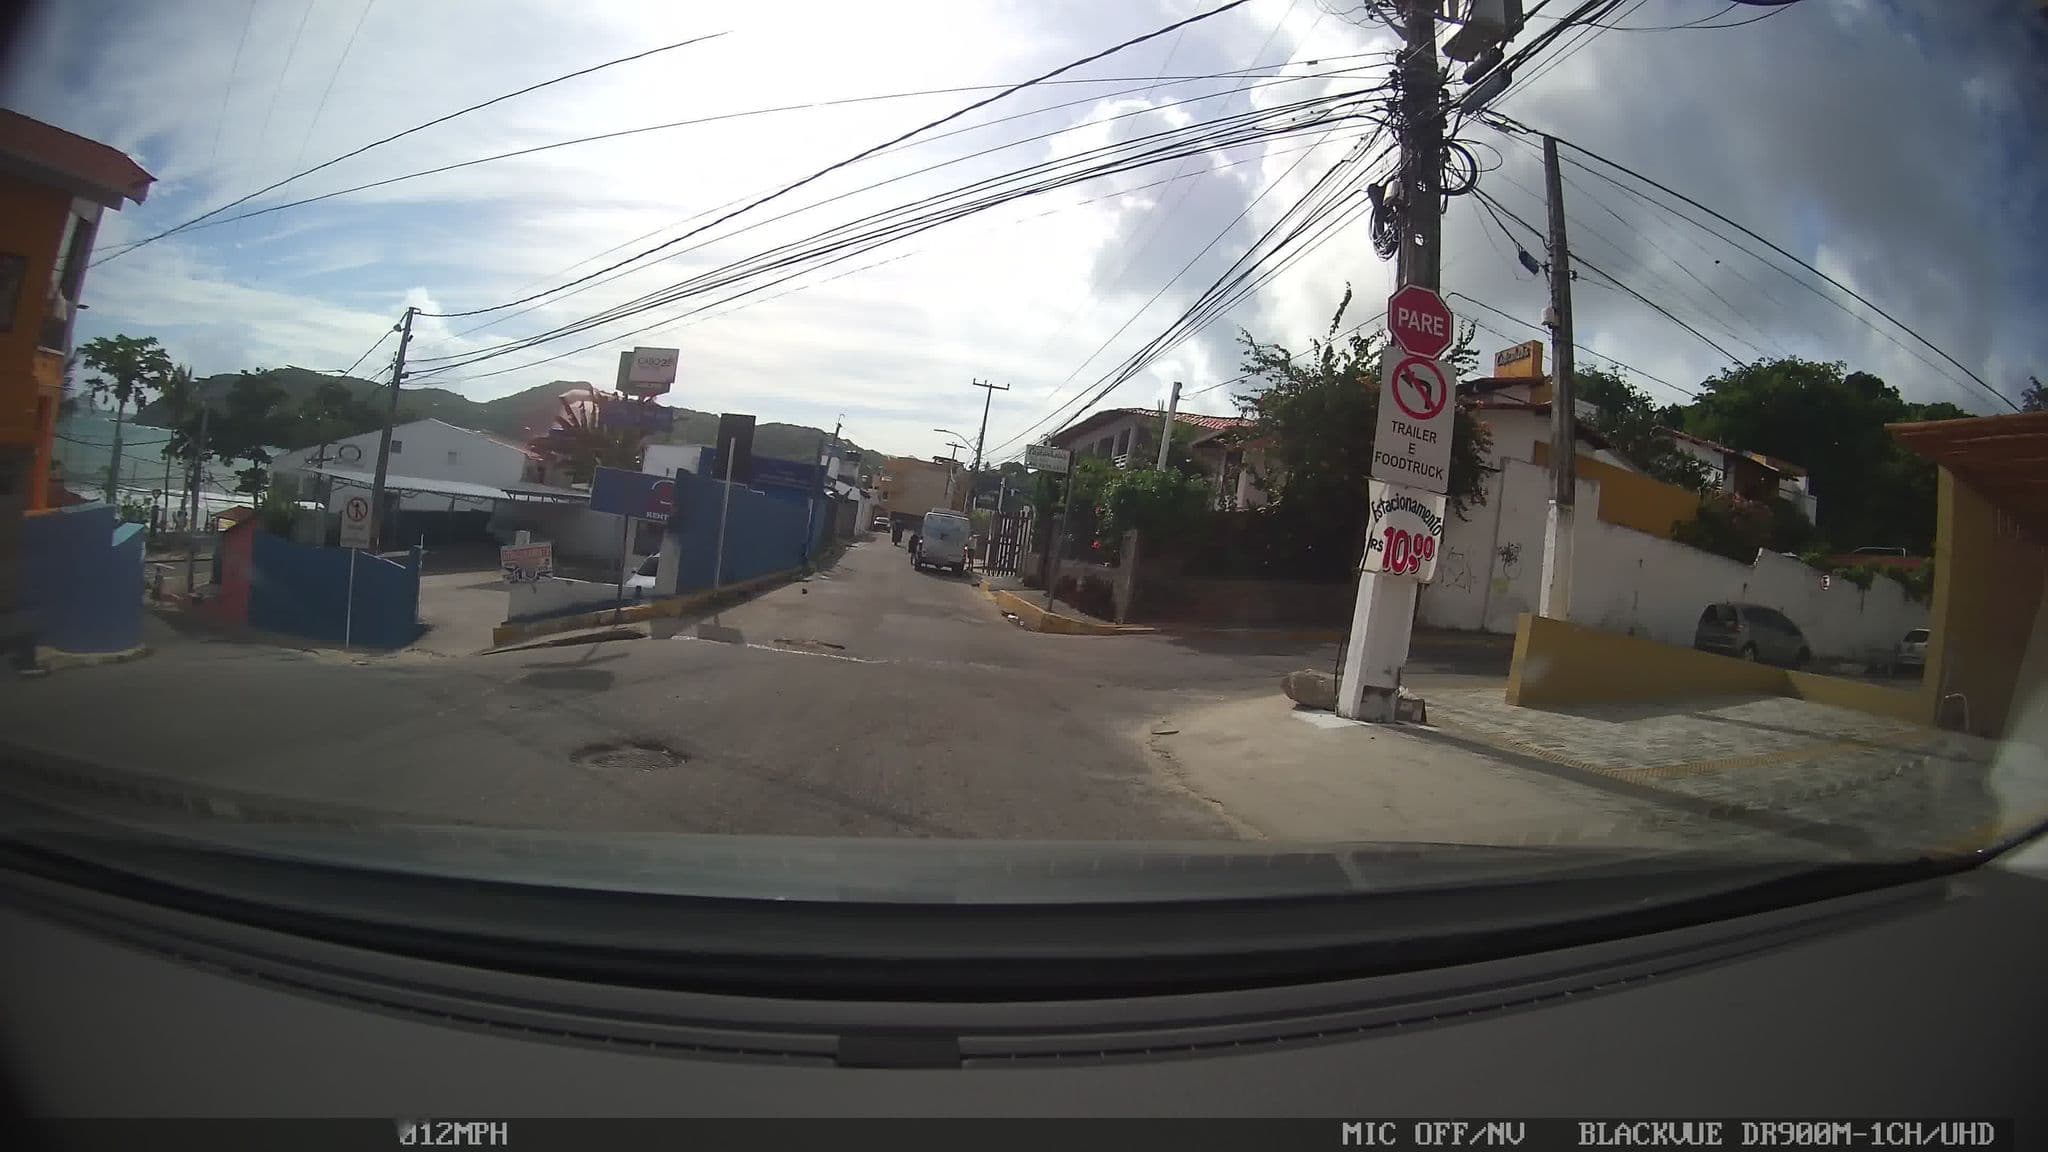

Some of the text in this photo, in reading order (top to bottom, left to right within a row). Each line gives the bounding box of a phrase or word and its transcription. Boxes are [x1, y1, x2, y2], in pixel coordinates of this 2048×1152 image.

[1398, 307, 1444, 337] PARE
[1391, 420, 1437, 444] TRAILER
[1408, 443, 1416, 455] E
[1374, 451, 1444, 480] FOODTRUCK
[1371, 493, 1442, 537] Estacionamento
[1382, 526, 1436, 575] 10,00
